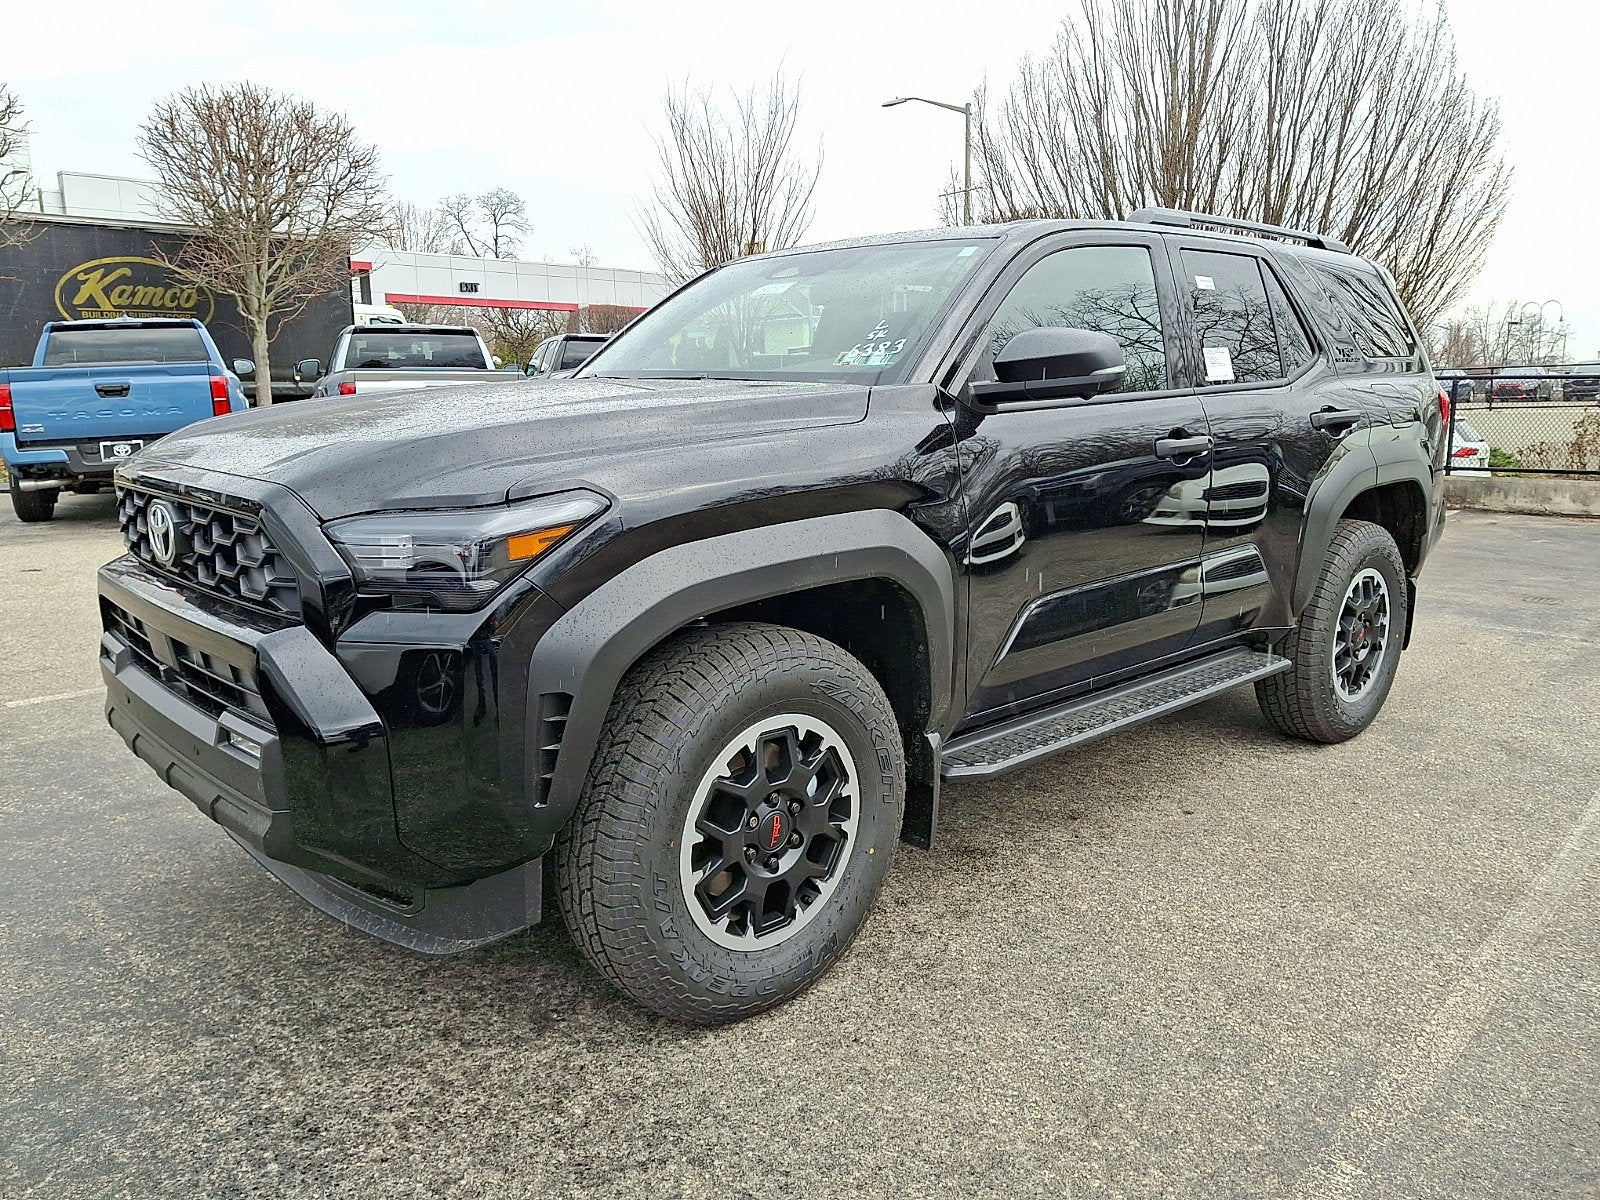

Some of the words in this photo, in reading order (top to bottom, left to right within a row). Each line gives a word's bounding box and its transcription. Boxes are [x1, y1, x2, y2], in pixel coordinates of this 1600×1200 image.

[72, 267, 198, 309] Kamco
[460, 282, 480, 293] EXIT
[847, 338, 907, 357] 6383
[48, 406, 184, 421] TACOMA
[809, 679, 895, 803] FALKEN
[769, 815, 782, 848] TRD
